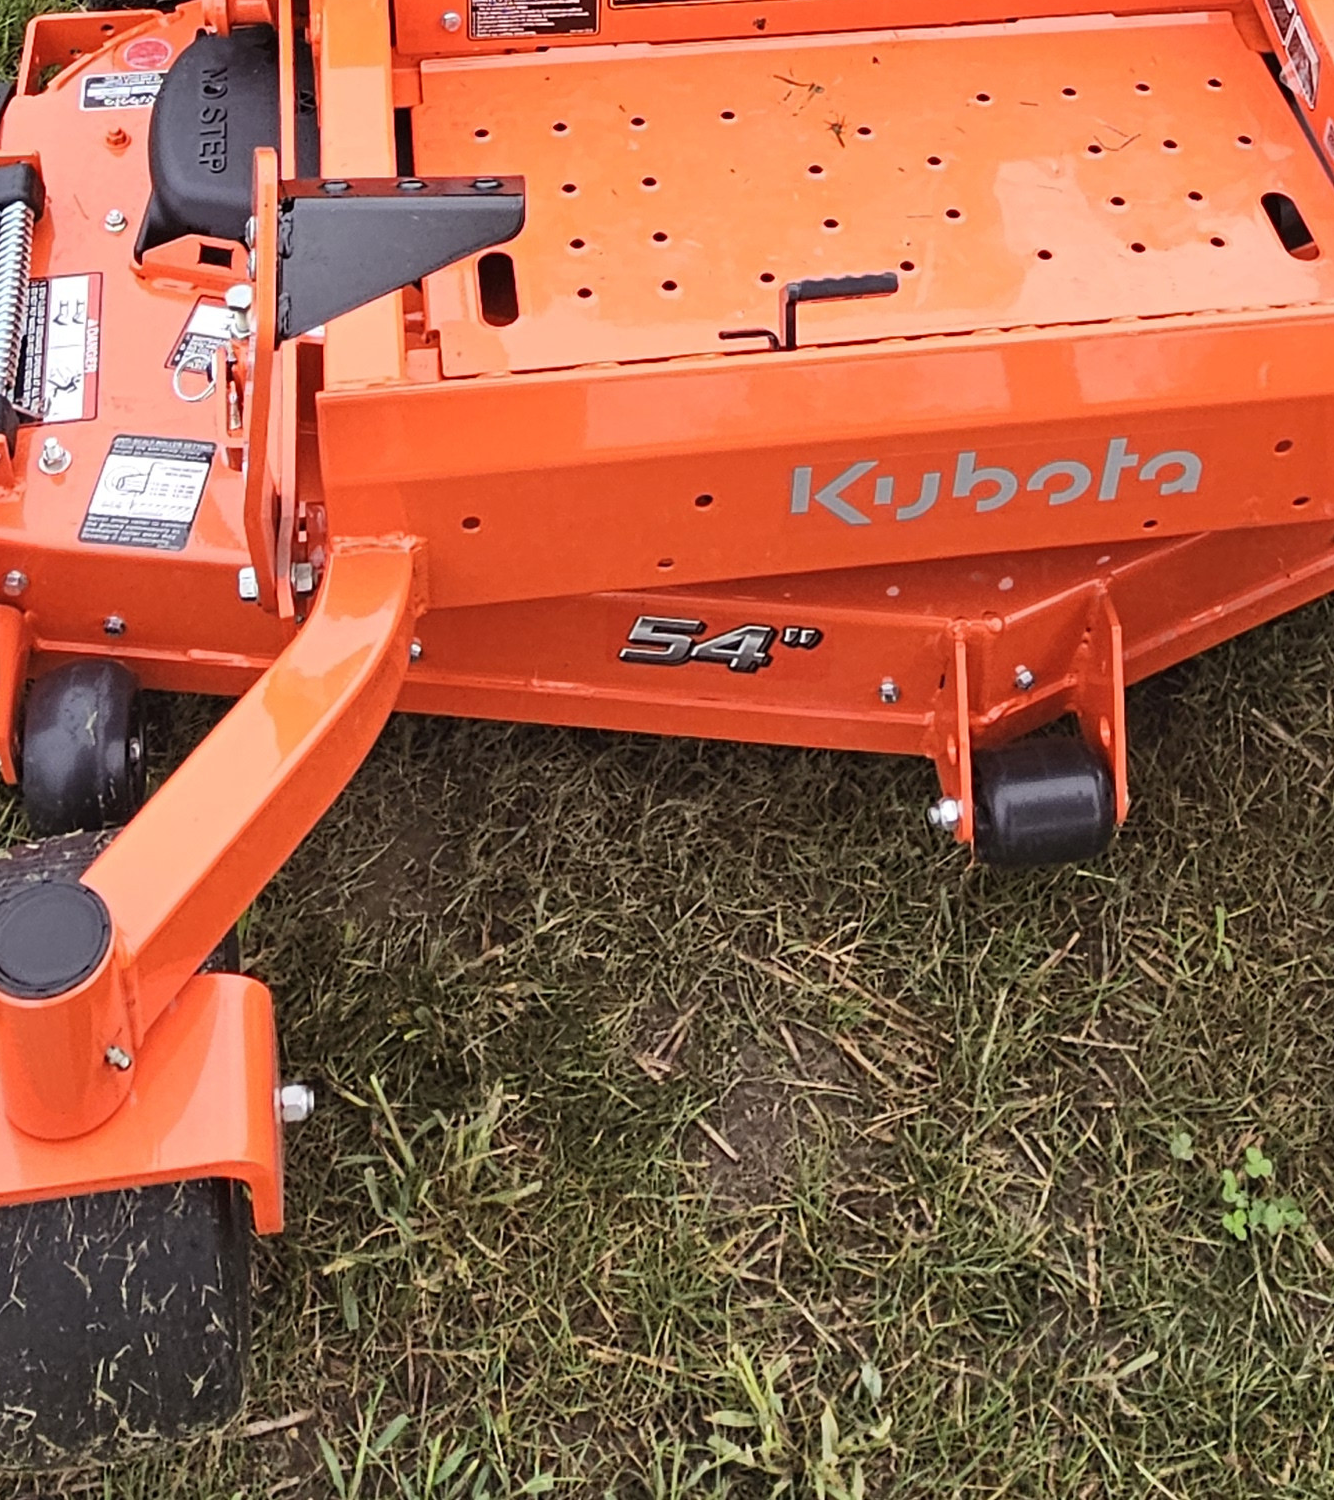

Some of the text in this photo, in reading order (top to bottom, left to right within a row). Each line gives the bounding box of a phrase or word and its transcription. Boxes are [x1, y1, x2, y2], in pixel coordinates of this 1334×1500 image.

[199, 67, 228, 174] NO STEP
[84, 327, 99, 373] DANGER
[789, 437, 1203, 526] Kubota
